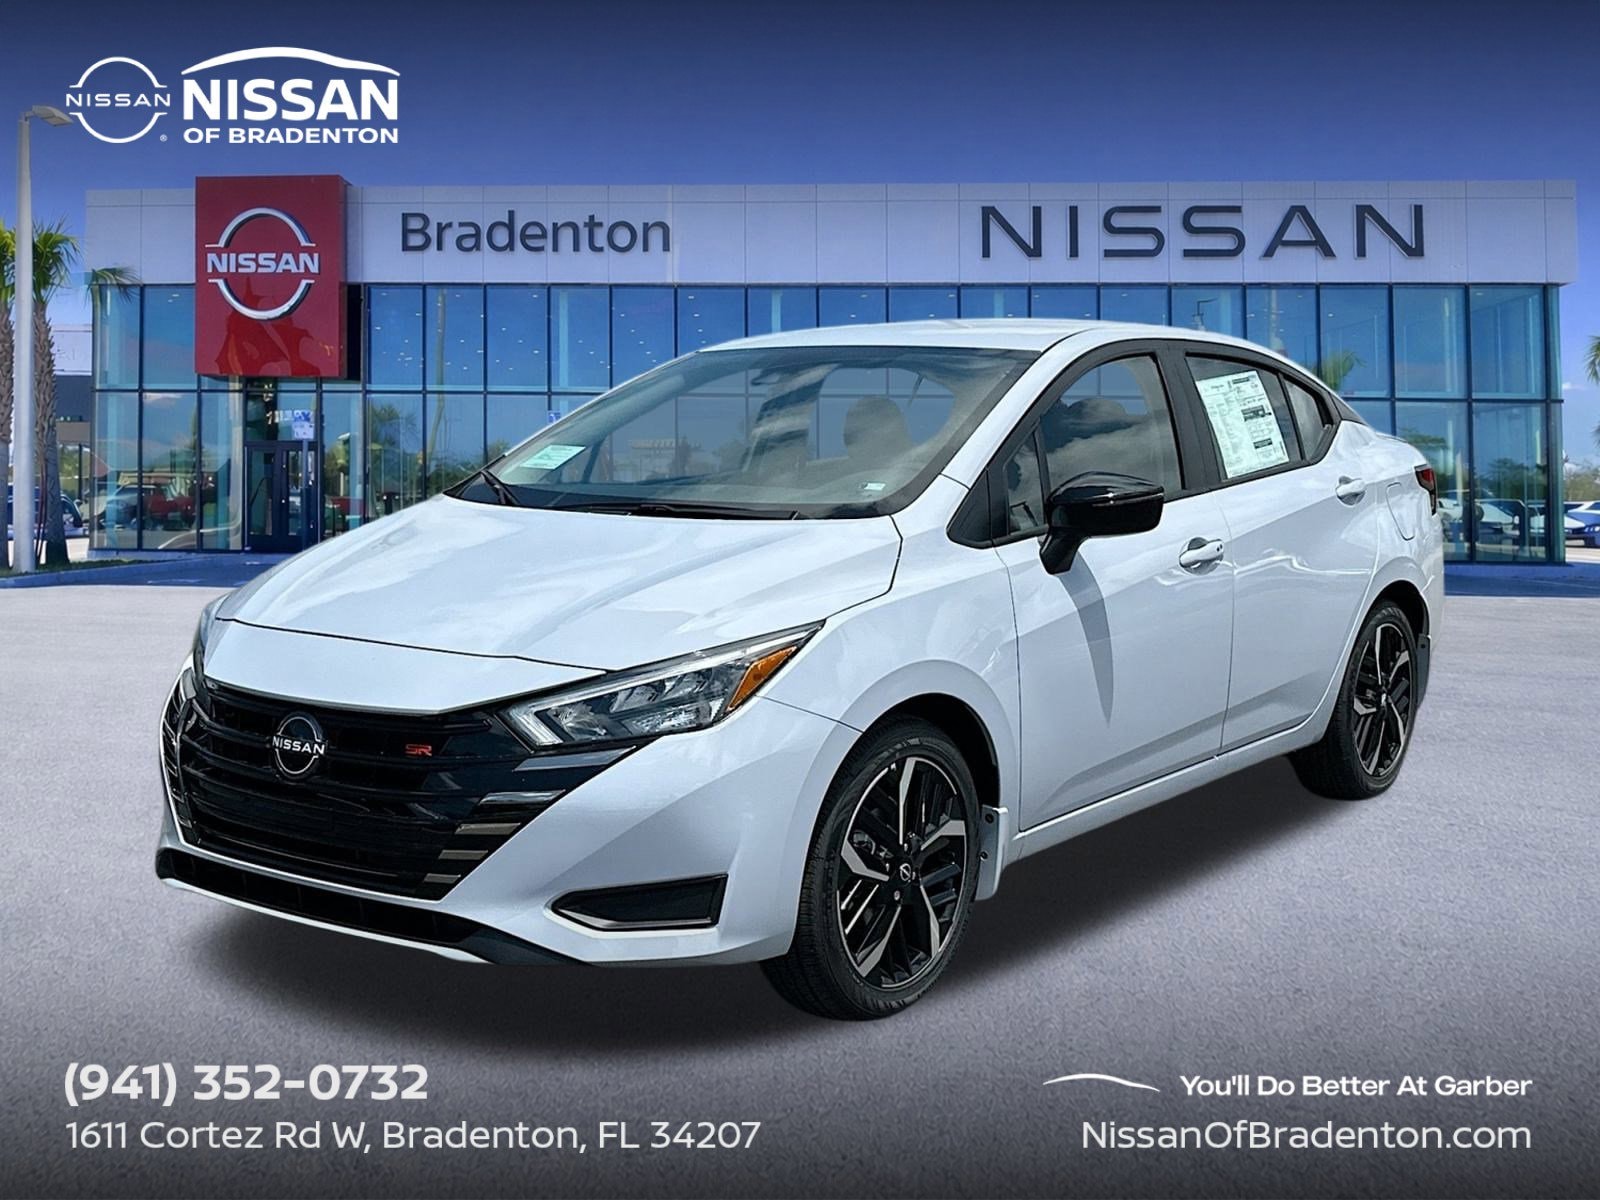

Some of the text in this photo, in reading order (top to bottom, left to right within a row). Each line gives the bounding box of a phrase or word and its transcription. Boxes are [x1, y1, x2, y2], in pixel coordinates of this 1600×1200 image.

[401, 209, 671, 253] Bradenton
[980, 204, 1425, 259] NISSAN
[206, 252, 319, 273] NISSAN
[272, 735, 325, 755] NISSAN
[405, 744, 433, 757] SR
